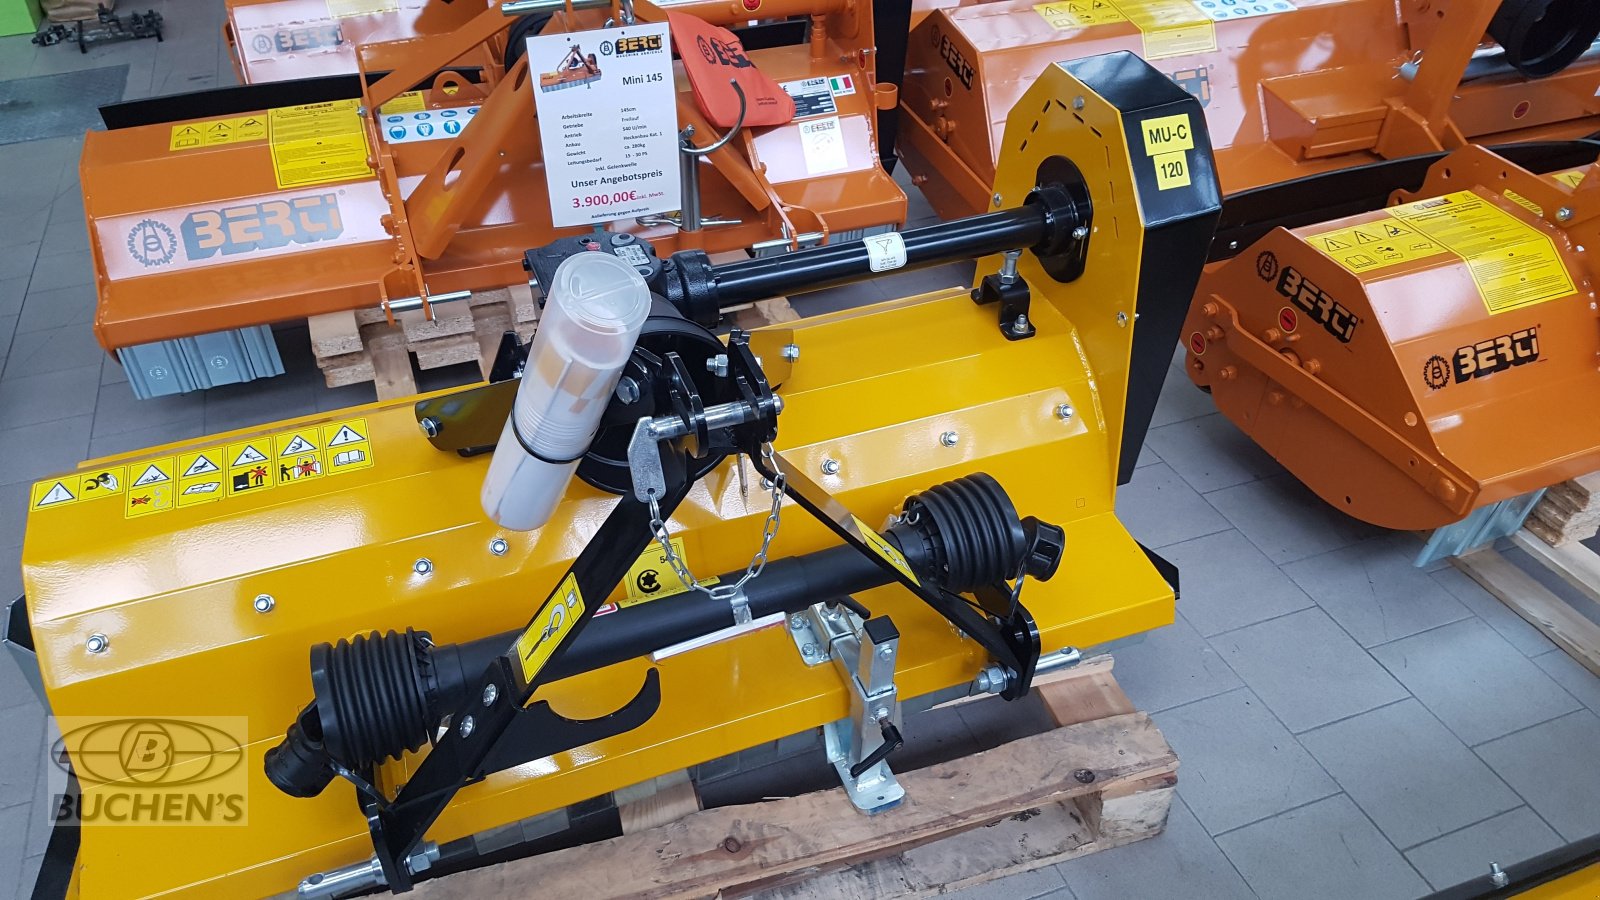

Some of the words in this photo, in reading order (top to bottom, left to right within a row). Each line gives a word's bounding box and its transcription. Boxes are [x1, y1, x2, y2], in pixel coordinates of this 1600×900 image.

[623, 75, 643, 85] Mini
[647, 73, 663, 82] 145
[562, 112, 592, 120] Arbeitsbreite
[1149, 124, 1187, 144] MU-C
[607, 162, 637, 170] Gelenkwelle
[1161, 161, 1183, 179] 120
[571, 178, 598, 188] Unser
[600, 169, 663, 186] Angebotspreis
[572, 190, 637, 210] 3.900,00€
